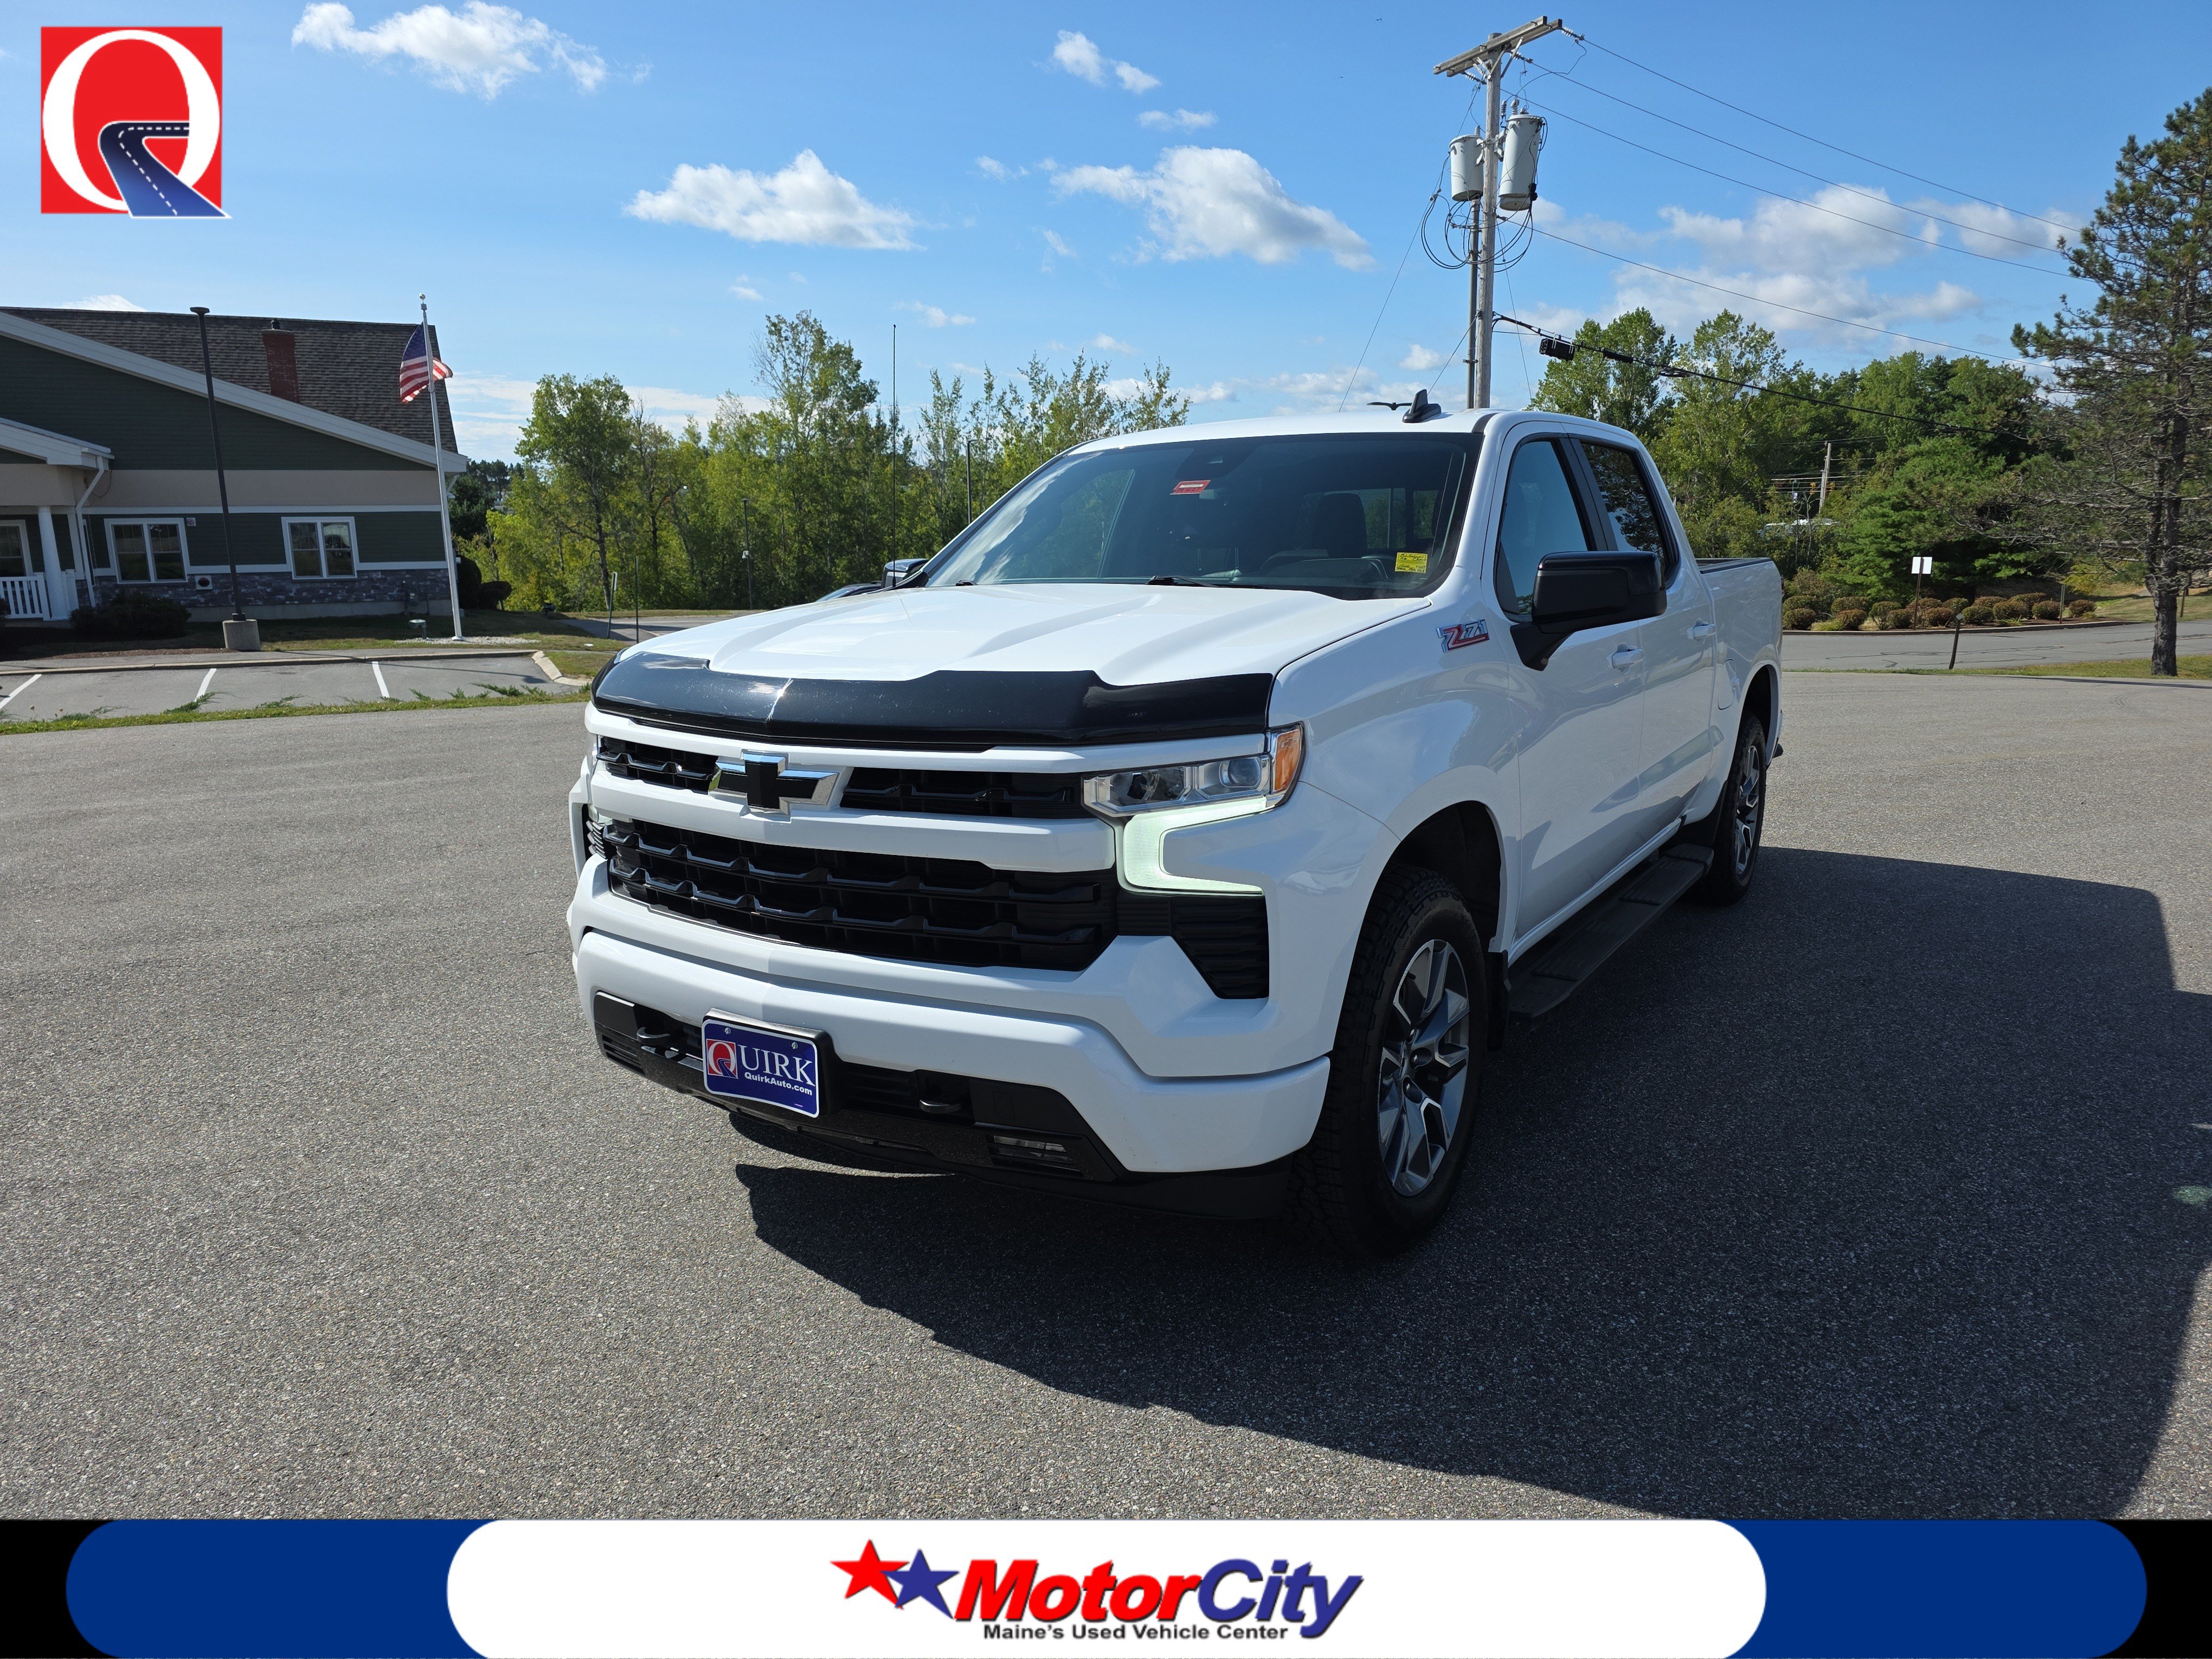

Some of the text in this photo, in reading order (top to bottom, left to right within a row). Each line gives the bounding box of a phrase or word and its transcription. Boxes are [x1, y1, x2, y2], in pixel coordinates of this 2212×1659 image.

[1436, 619, 1490, 653] Z71
[707, 1041, 815, 1086] QUIRK
[744, 1072, 812, 1096] QuirkAuto.com
